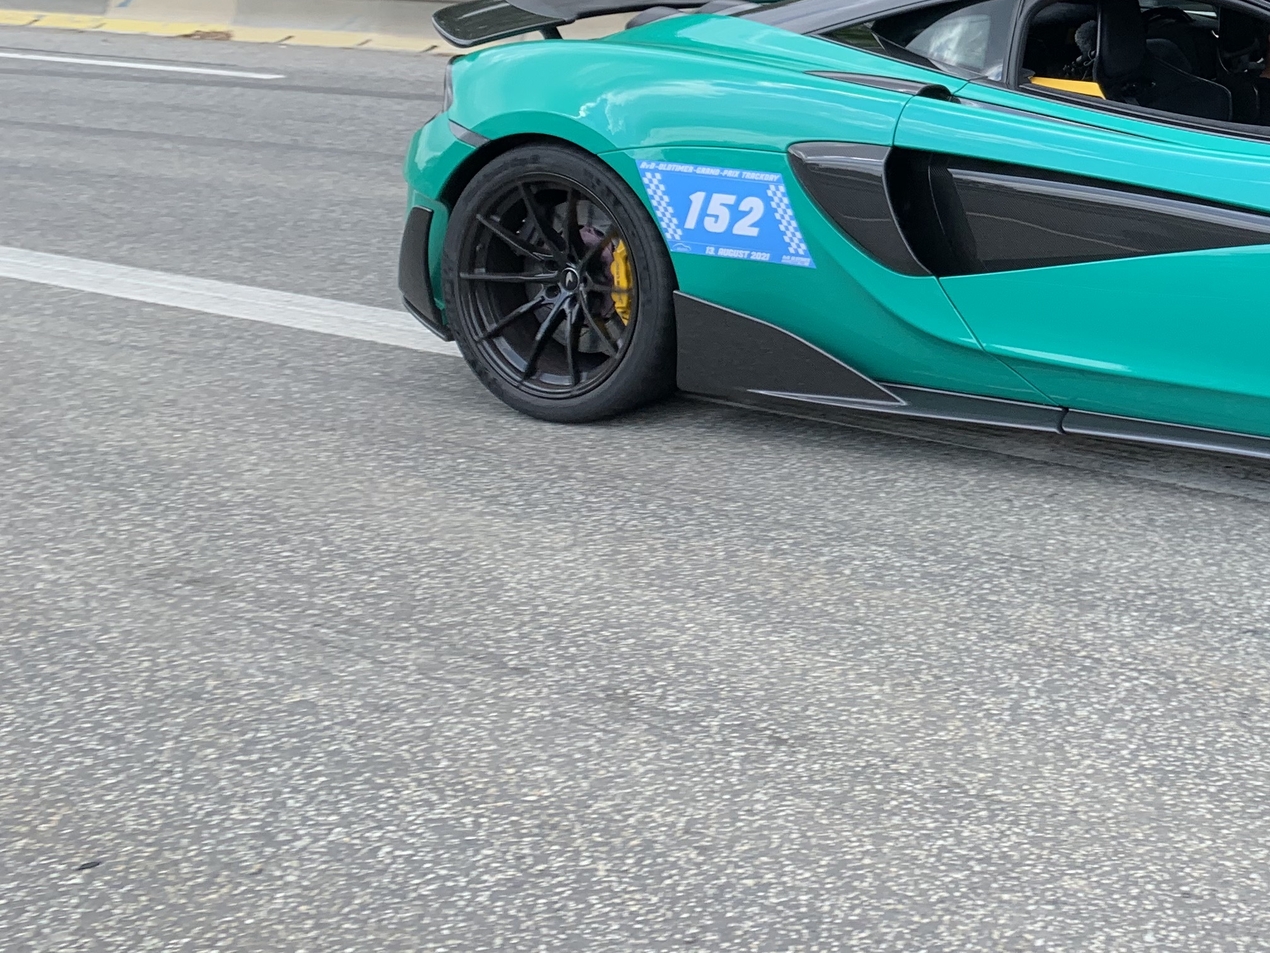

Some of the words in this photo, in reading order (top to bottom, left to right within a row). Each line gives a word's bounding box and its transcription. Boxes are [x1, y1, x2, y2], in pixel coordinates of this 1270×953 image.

[741, 171, 780, 182] TRACKDAY
[684, 191, 765, 237] 152
[717, 247, 750, 259] AUGUST
[750, 251, 770, 261] 2021
